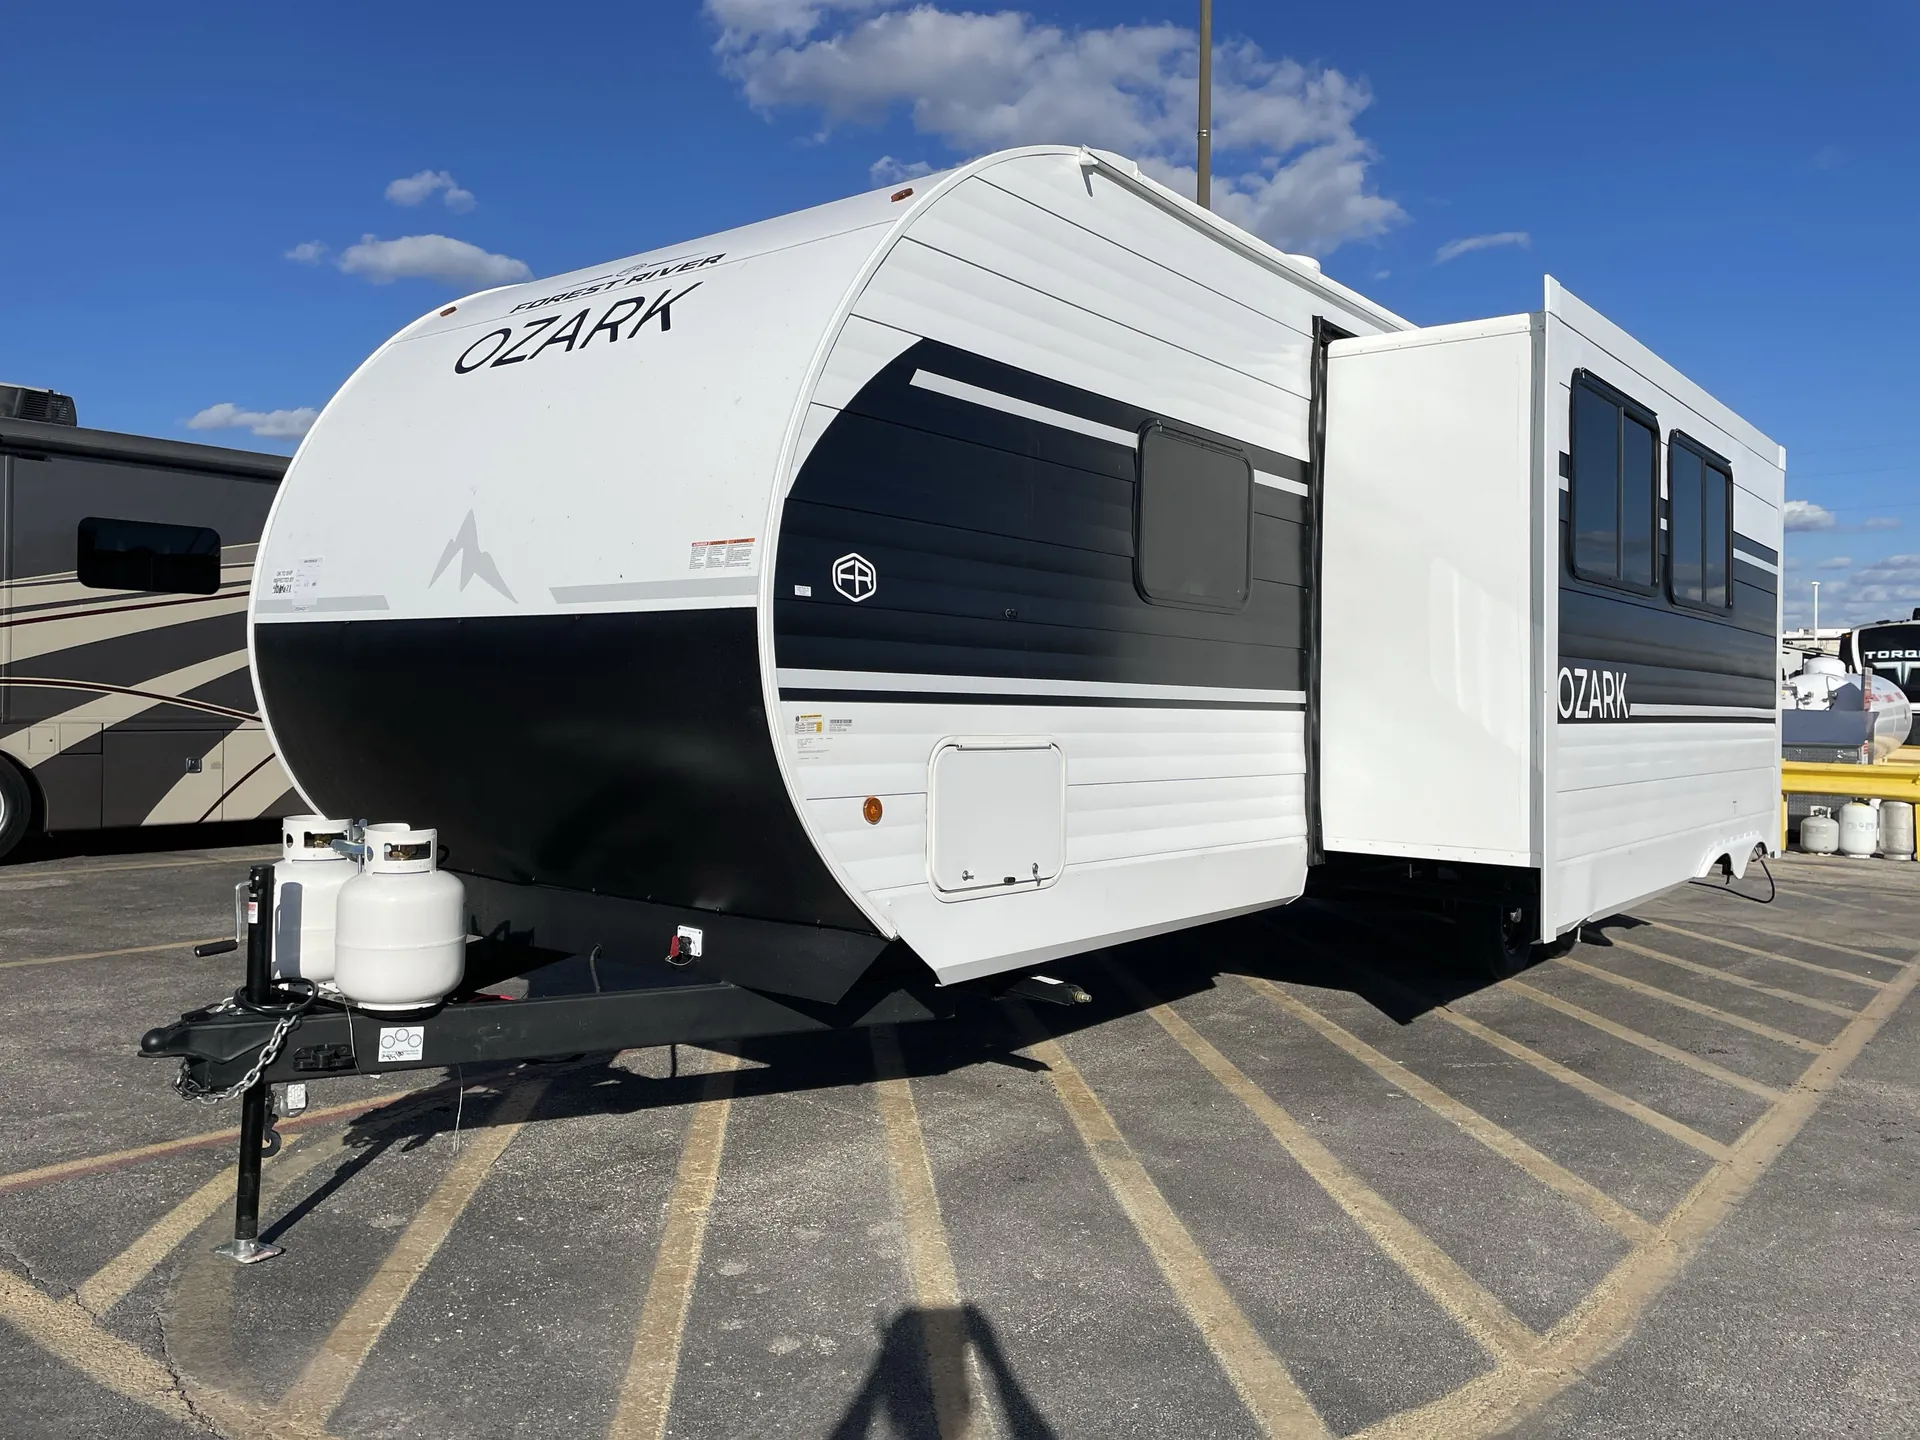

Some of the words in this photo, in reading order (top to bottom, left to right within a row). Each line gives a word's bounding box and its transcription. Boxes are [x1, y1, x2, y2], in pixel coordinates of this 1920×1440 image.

[509, 279, 625, 314] FOREST
[624, 253, 727, 285] RIVER
[454, 281, 705, 375] OZARK
[1865, 650, 1920, 659] TORQ
[1557, 666, 1629, 719] OZARK
